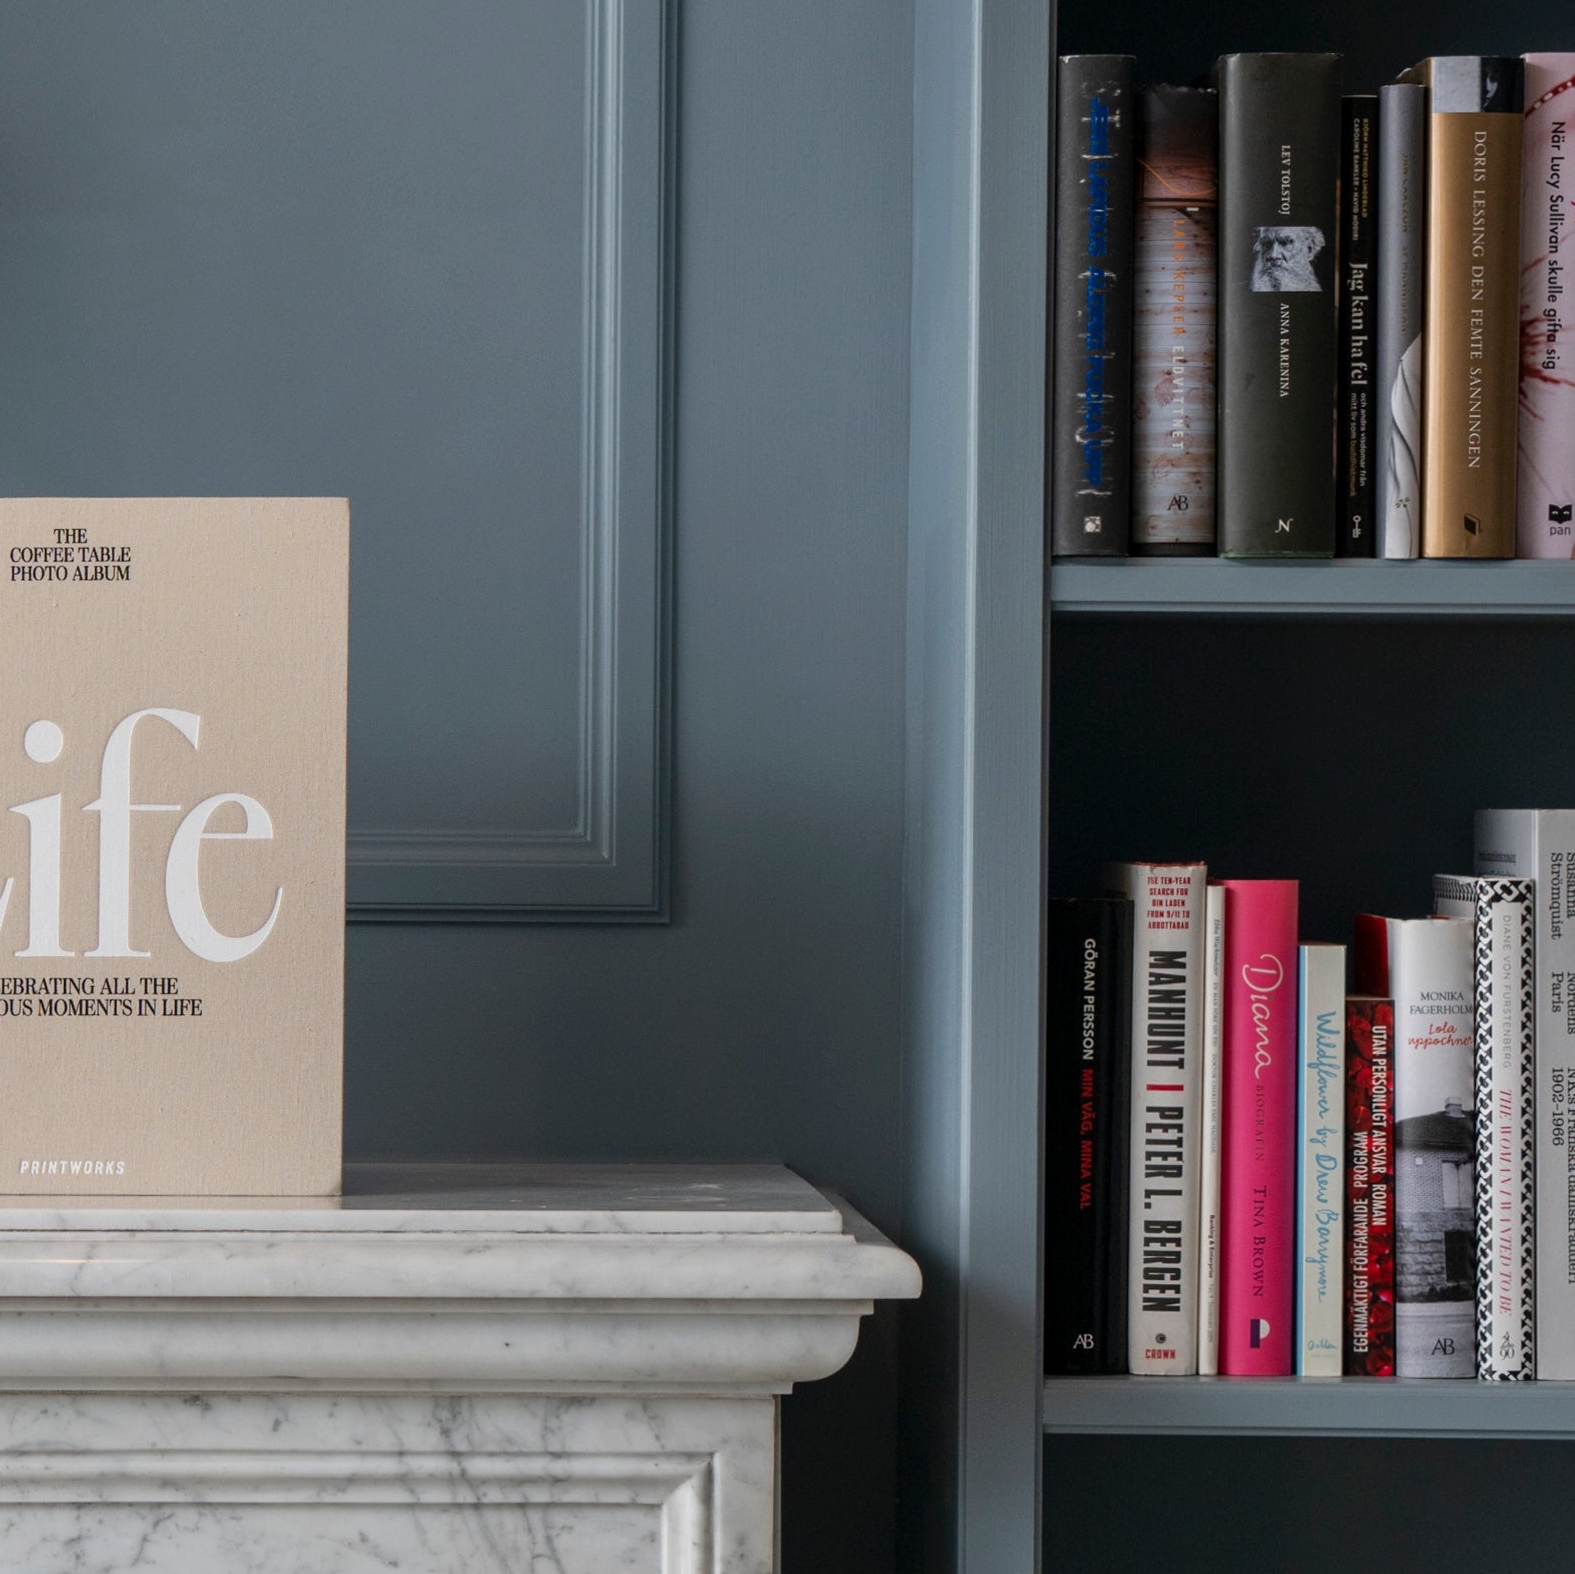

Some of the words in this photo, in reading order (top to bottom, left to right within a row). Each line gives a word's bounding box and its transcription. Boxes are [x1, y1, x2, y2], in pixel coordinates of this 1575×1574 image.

[1282, 145, 1290, 165] LEV
[1552, 122, 1565, 150] När
[1474, 132, 1486, 181] DORIS
[1546, 157, 1564, 188] Lucy
[1278, 169, 1291, 215] TOLSTOJ
[1473, 191, 1485, 257] LESSING
[1549, 195, 1564, 253] Sullivan
[1348, 264, 1367, 291] Jag
[1472, 267, 1483, 299] DEN
[1548, 260, 1563, 302] skulle
[1281, 303, 1289, 334] ANNA
[1352, 296, 1368, 329] kan
[1543, 309, 1562, 342] gifta
[1352, 336, 1368, 357] ha
[1471, 310, 1482, 359] FEMTE
[1280, 339, 1289, 397] KARENINA
[1351, 362, 1367, 384] fel
[1542, 349, 1559, 369] sig
[1469, 368, 1481, 467] SANNINGEN
[8, 547, 75, 564] COFFEE
[79, 547, 131, 564] TABLE
[53, 528, 88, 545] THE
[8, 564, 70, 582] PHOTO
[72, 564, 131, 582] ALBUM
[1549, 853, 1563, 939] Strömquist
[1084, 939, 1098, 990] GÖRAN
[99, 977, 135, 995] ALL
[139, 977, 179, 995] THE
[1552, 972, 1564, 1012] Paris
[37, 998, 133, 1017] MOMENTS
[137, 998, 157, 1017] IN
[162, 998, 202, 1017] LIFE
[1083, 996, 1094, 1059] PERSSON
[1146, 951, 1186, 1070] MANHUNT
[1372, 1026, 1386, 1055] UTAN
[1082, 1069, 1093, 1097] MIN
[1308, 1011, 1340, 1119] Wildflower
[1369, 1059, 1386, 1122] PERSONLIGT
[1145, 1107, 1183, 1177] PETER
[1309, 1126, 1336, 1147] by
[1372, 1130, 1386, 1173] ANSVAR
[18, 1159, 124, 1174] PRINTWORKS
[1081, 1141, 1092, 1178] MINA
[1316, 1153, 1337, 1203] Drew
[1351, 1132, 1371, 1187] PROGRAM
[1080, 1184, 1091, 1209] VAL
[1144, 1189, 1182, 1209] L.
[1254, 1186, 1266, 1226] TINA
[1373, 1185, 1386, 1225] ROMAN
[1350, 1199, 1368, 1268] FÖRFARANDE
[1142, 1220, 1181, 1312] BERGEN
[1254, 1237, 1266, 1296] BROWN
[1306, 1209, 1339, 1302] Barrymore
[1354, 1275, 1368, 1352] EGENMÄKTIGT
[1146, 1349, 1175, 1358] CROWN
